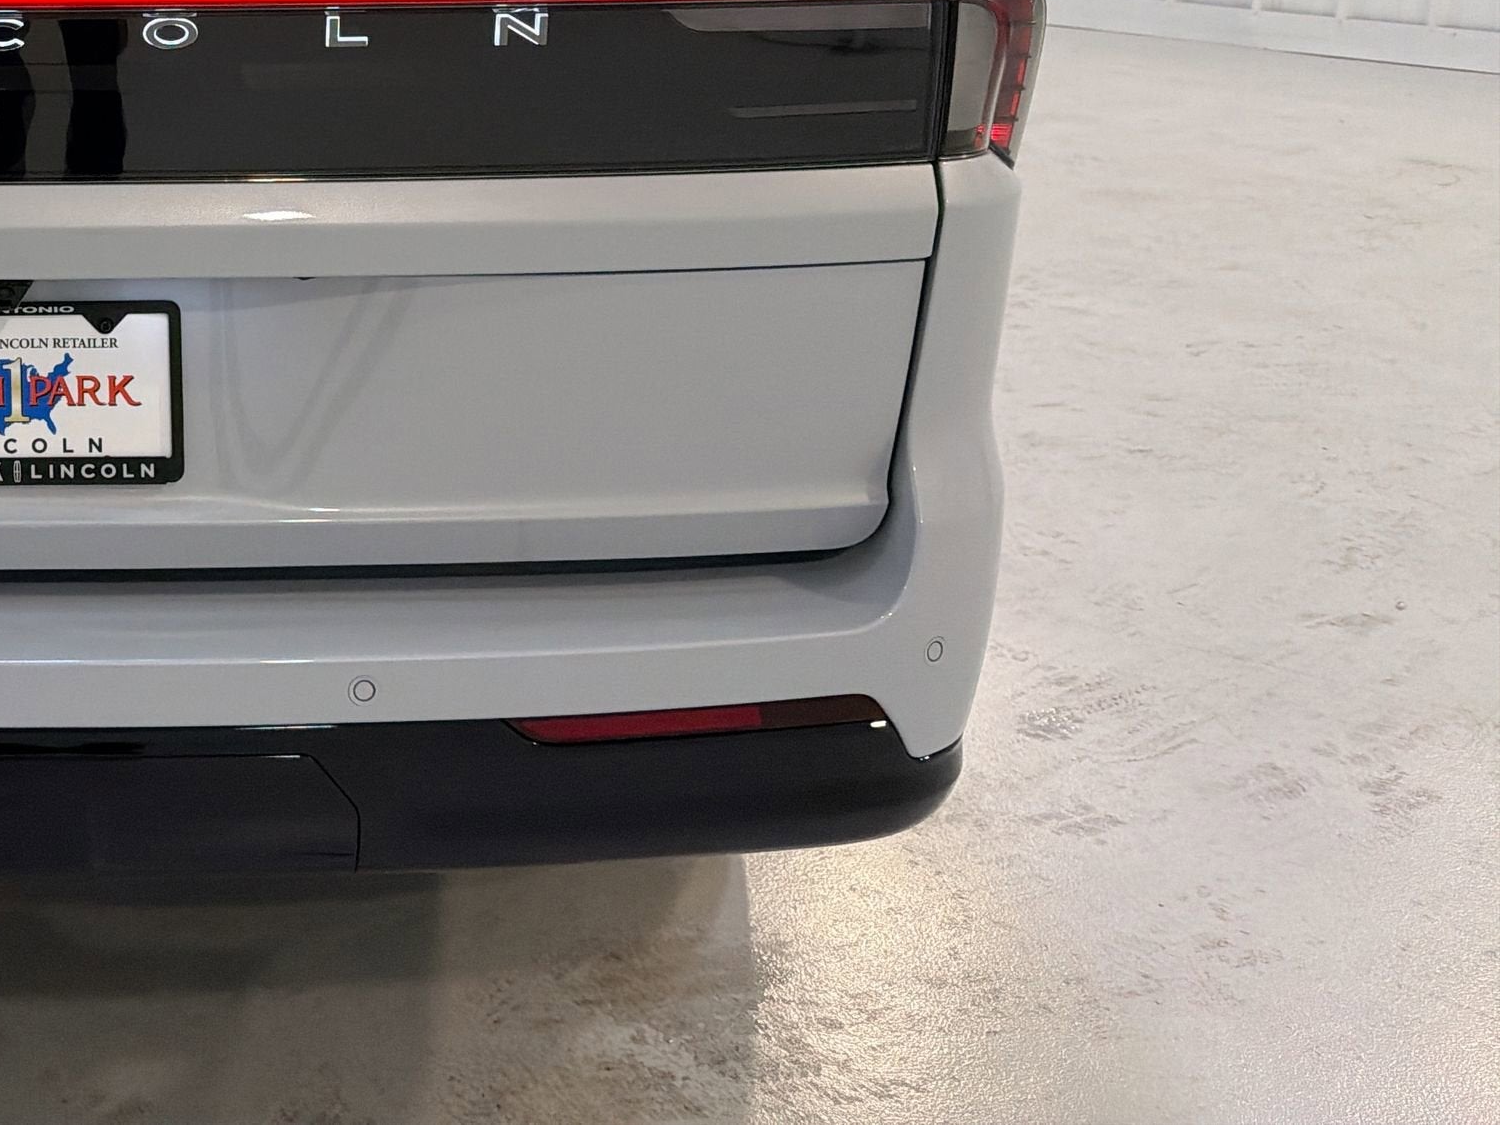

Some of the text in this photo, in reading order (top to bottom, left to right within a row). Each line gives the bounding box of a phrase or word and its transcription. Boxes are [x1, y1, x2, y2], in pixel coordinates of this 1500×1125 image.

[52, 337, 119, 349] RETAILER
[29, 374, 143, 408] PARK
[30, 462, 156, 480] LINCOLN
